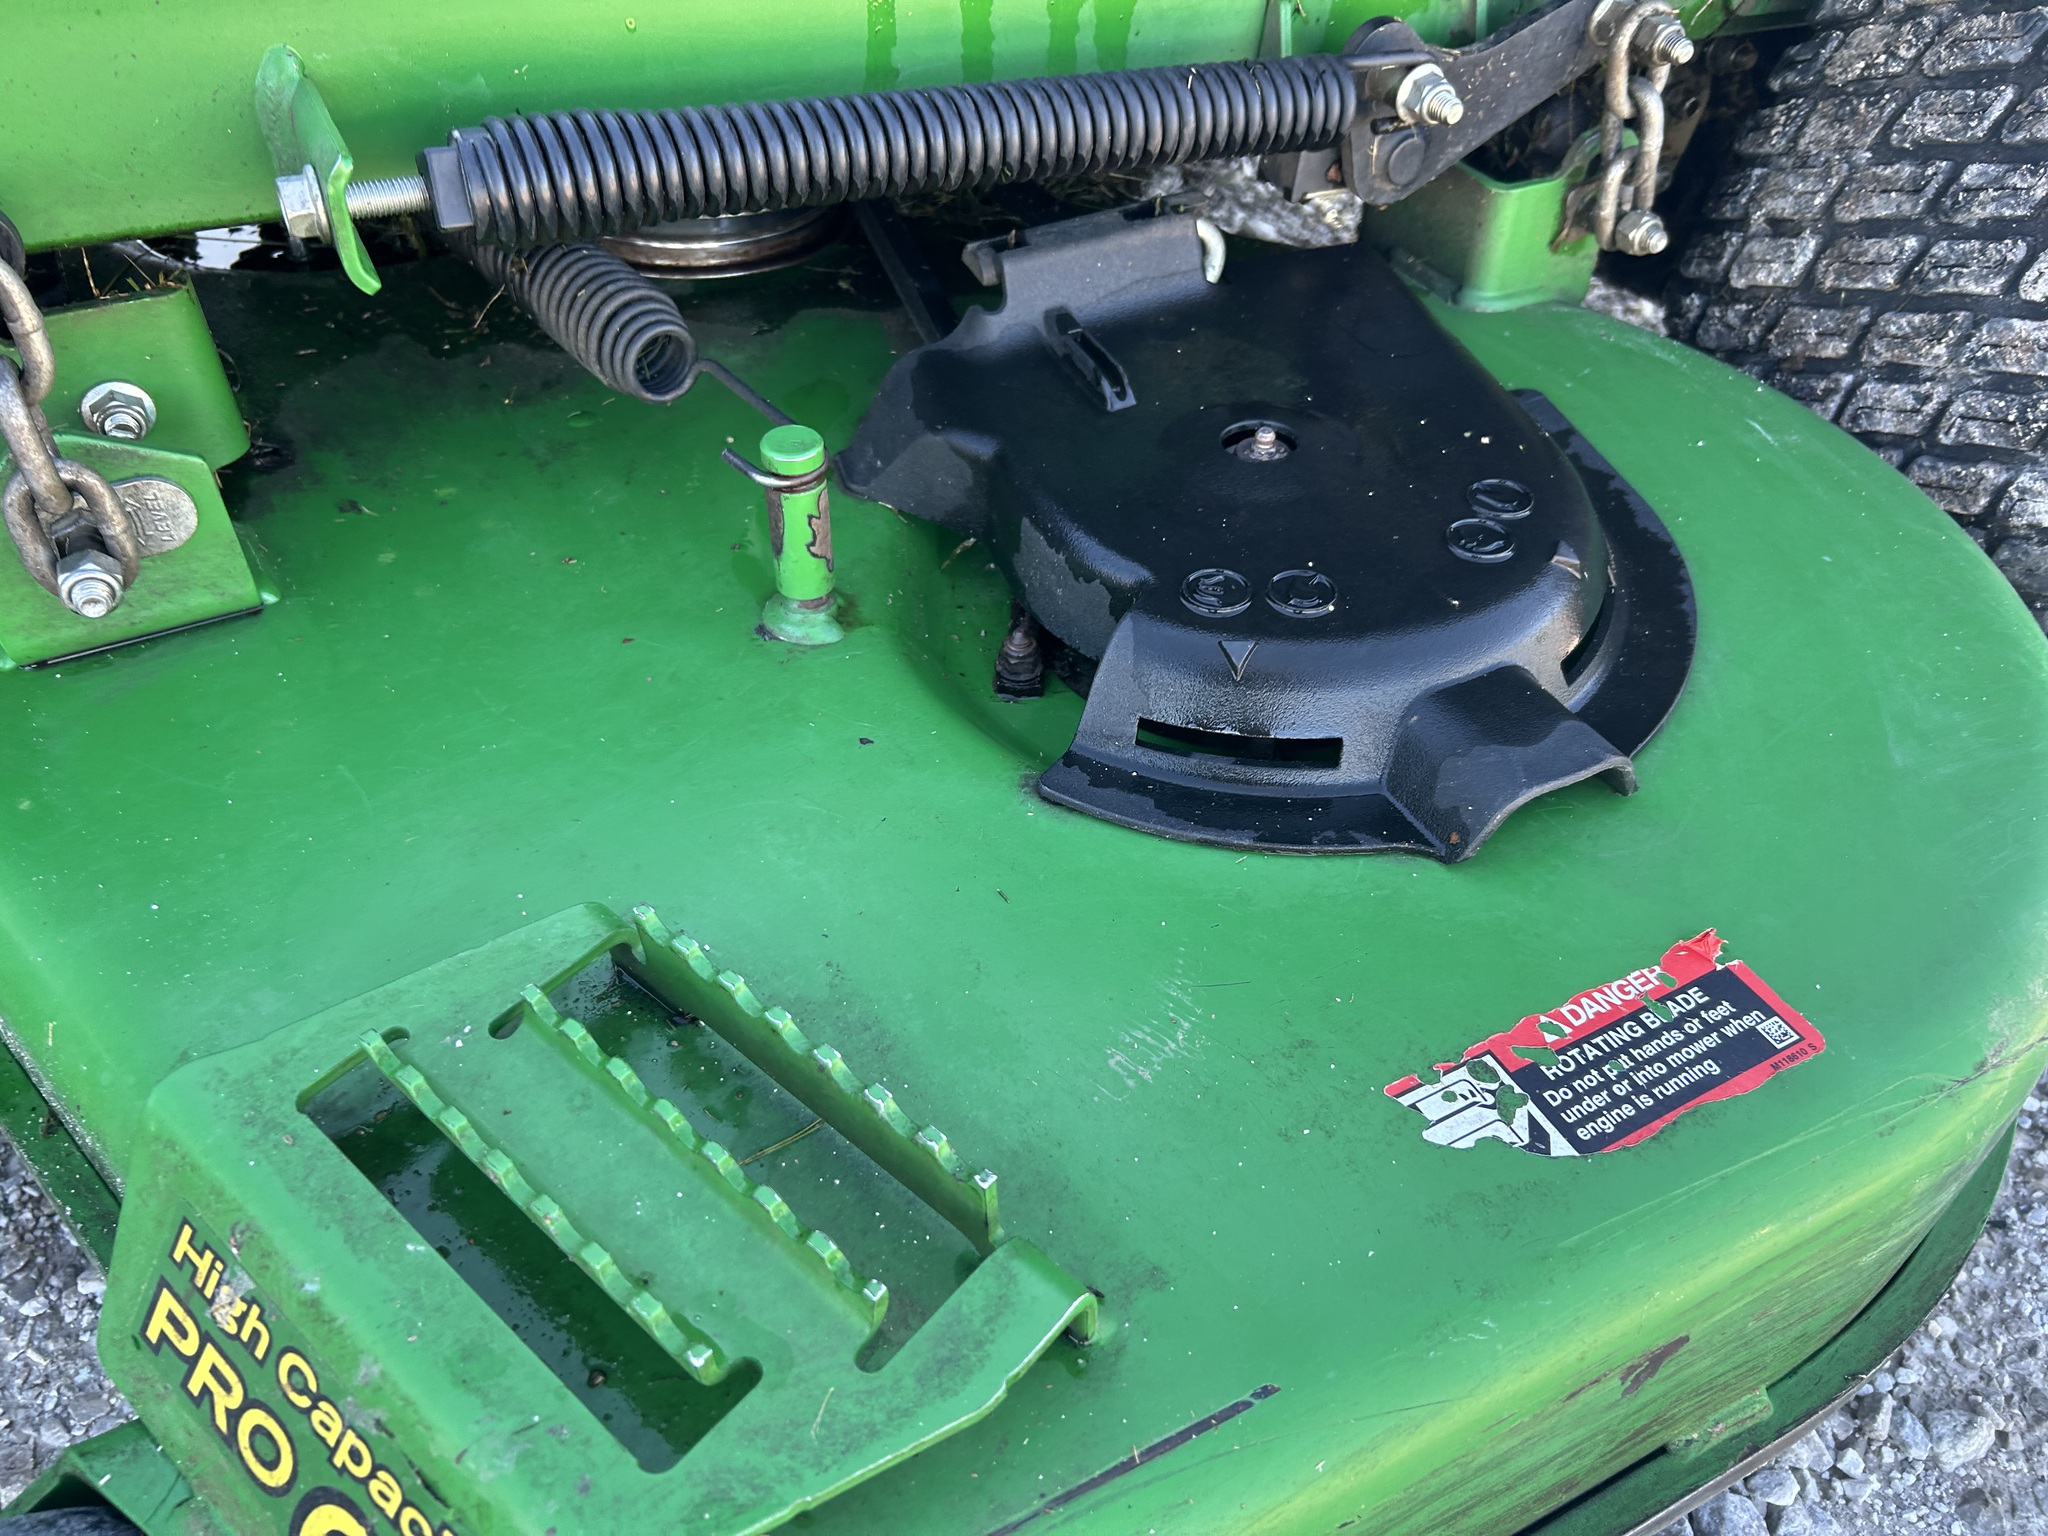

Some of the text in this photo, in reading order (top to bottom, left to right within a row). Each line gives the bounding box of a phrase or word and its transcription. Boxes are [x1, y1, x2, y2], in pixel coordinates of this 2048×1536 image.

[1542, 1087, 1573, 1107] Do
[1572, 1067, 1605, 1093] not
[1628, 1028, 1685, 1061] hands
[1682, 1014, 1705, 1034] or
[1702, 1000, 1737, 1025] feet
[1639, 986, 1710, 1030] BADE
[1769, 1042, 1818, 1073] M118610 S
[1560, 1008, 1767, 1124] under or into mower when
[1576, 1057, 1721, 1141] engine is running
[145, 1286, 294, 1489] PRO
[277, 1351, 455, 1536] Capac
